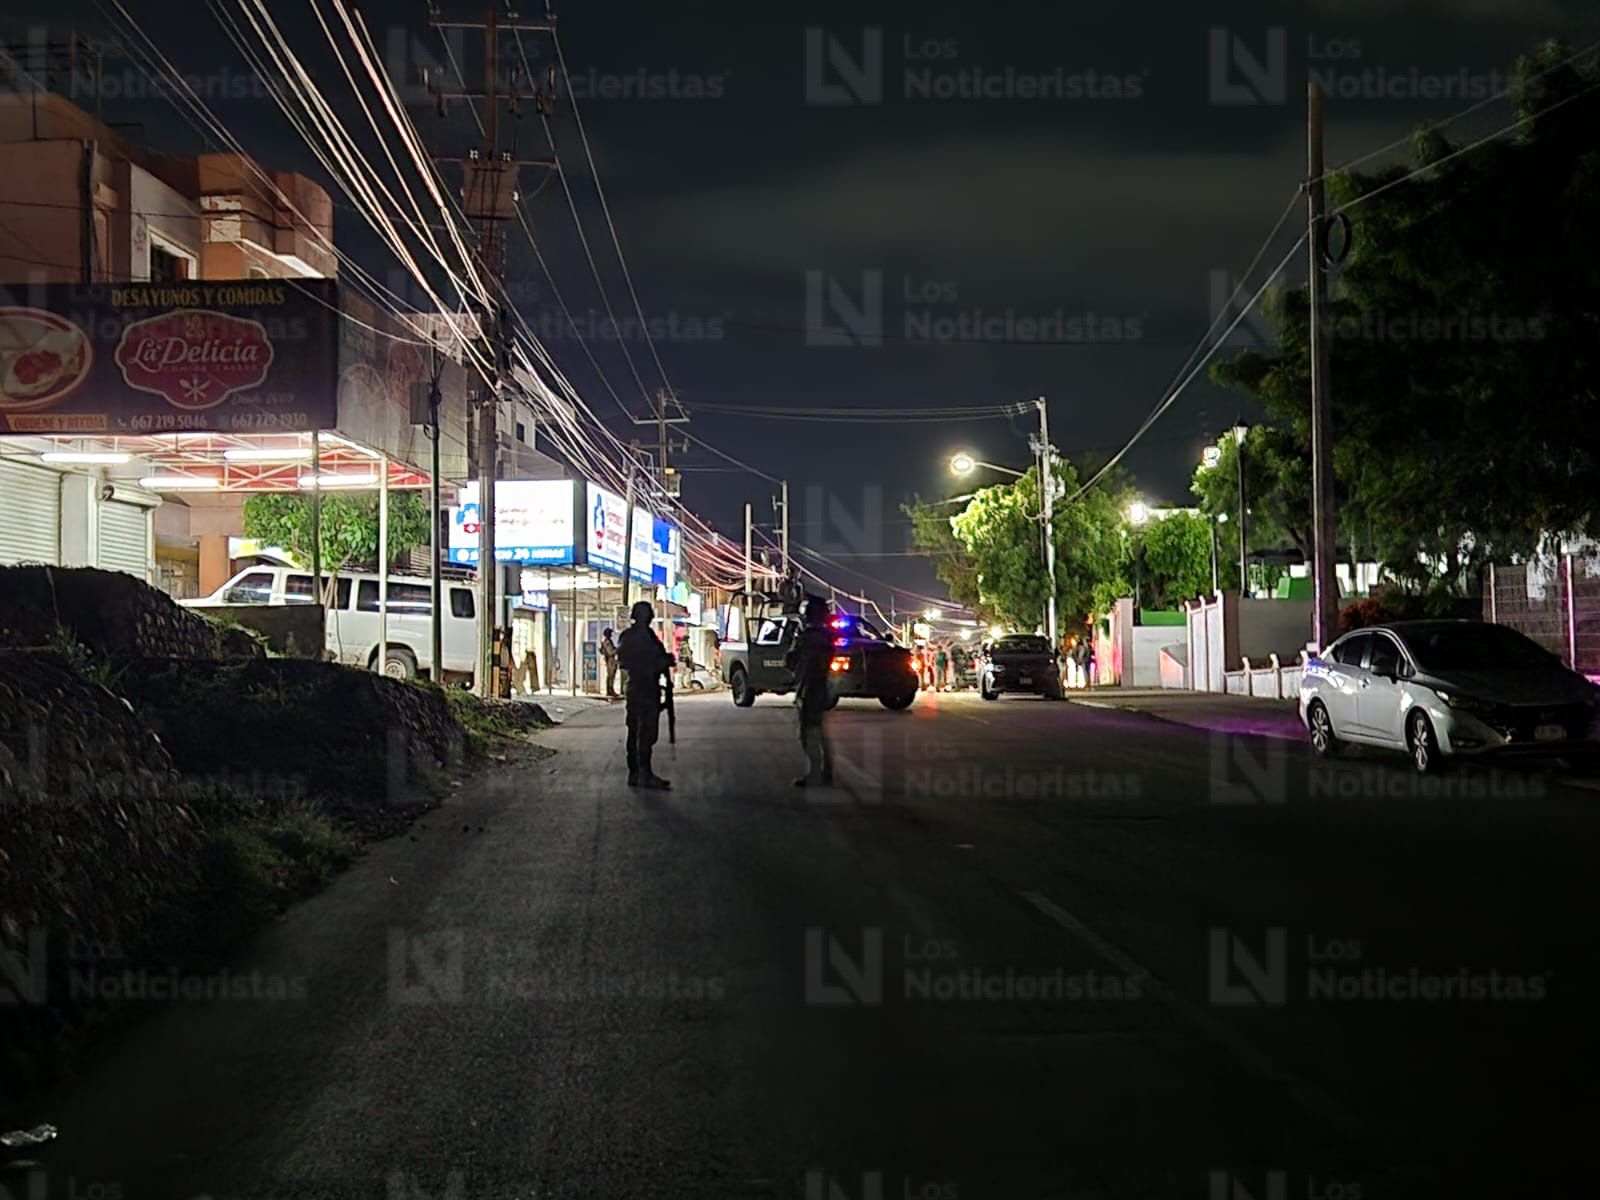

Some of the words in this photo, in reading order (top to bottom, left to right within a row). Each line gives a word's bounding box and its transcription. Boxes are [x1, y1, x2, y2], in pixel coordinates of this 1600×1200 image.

[111, 287, 199, 306] DESAYUNOS
[203, 288, 214, 305] Y
[217, 286, 285, 305] COMIDAS
[159, 337, 259, 366] Delicia
[131, 414, 153, 429] 667
